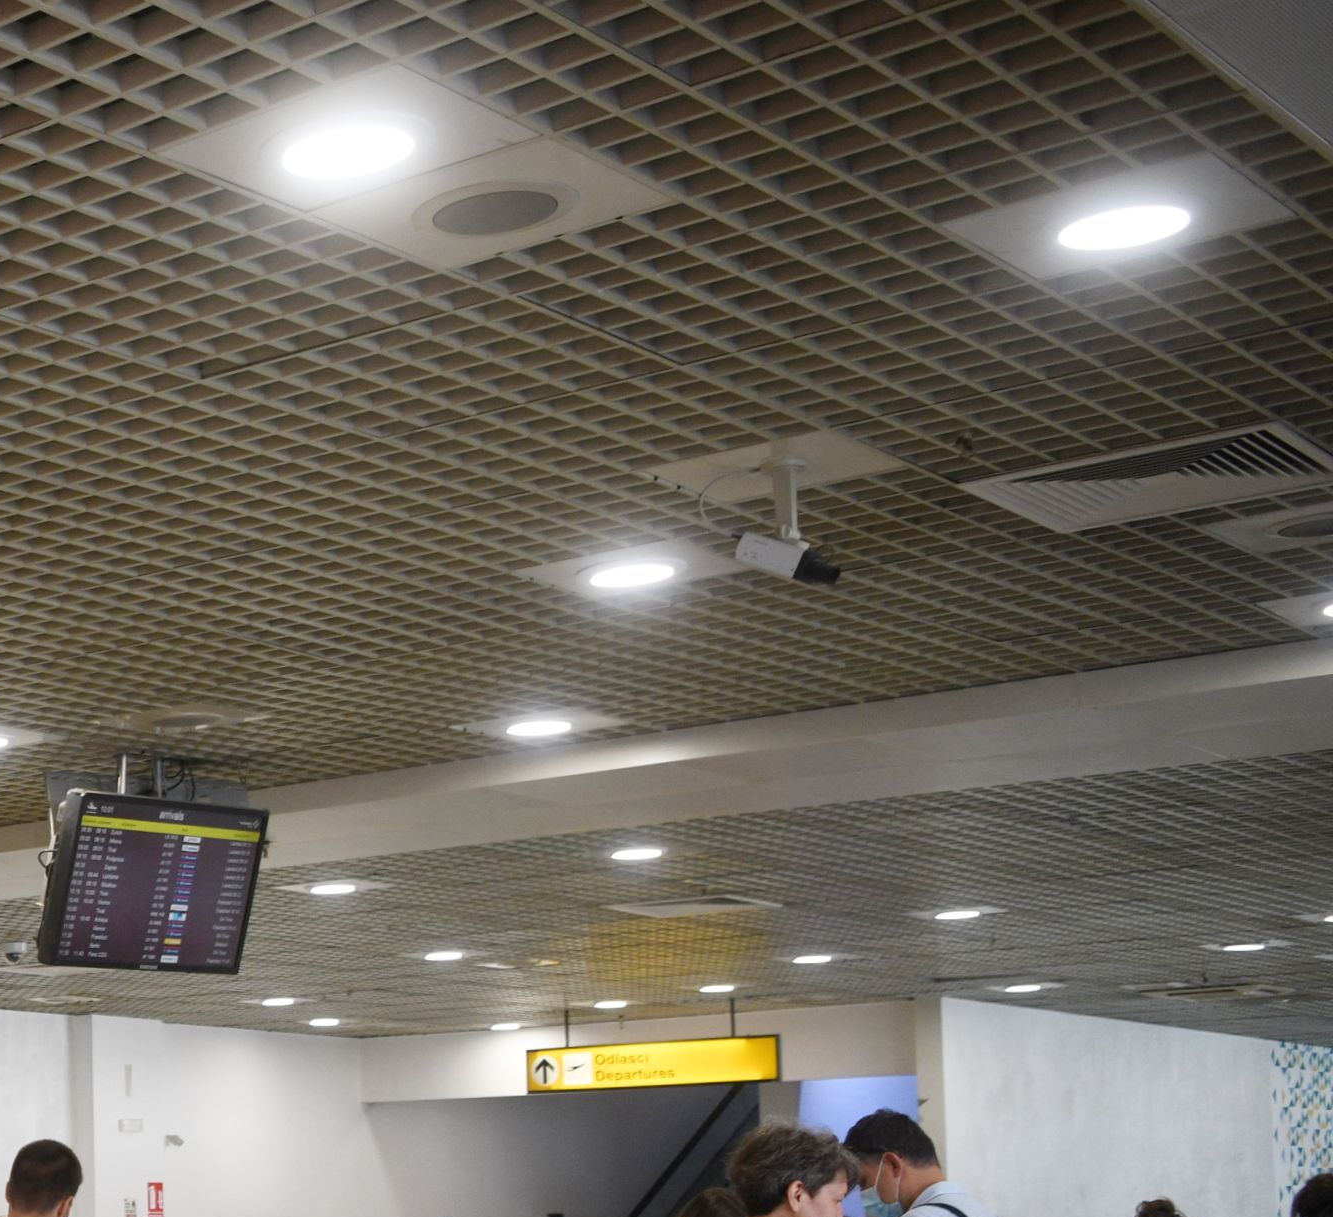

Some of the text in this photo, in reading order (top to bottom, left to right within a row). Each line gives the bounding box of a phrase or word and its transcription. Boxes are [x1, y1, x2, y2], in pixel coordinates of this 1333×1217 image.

[159, 809, 184, 821] arrivals
[595, 1054, 649, 1066] Odlasci
[595, 1068, 675, 1082] Departures
